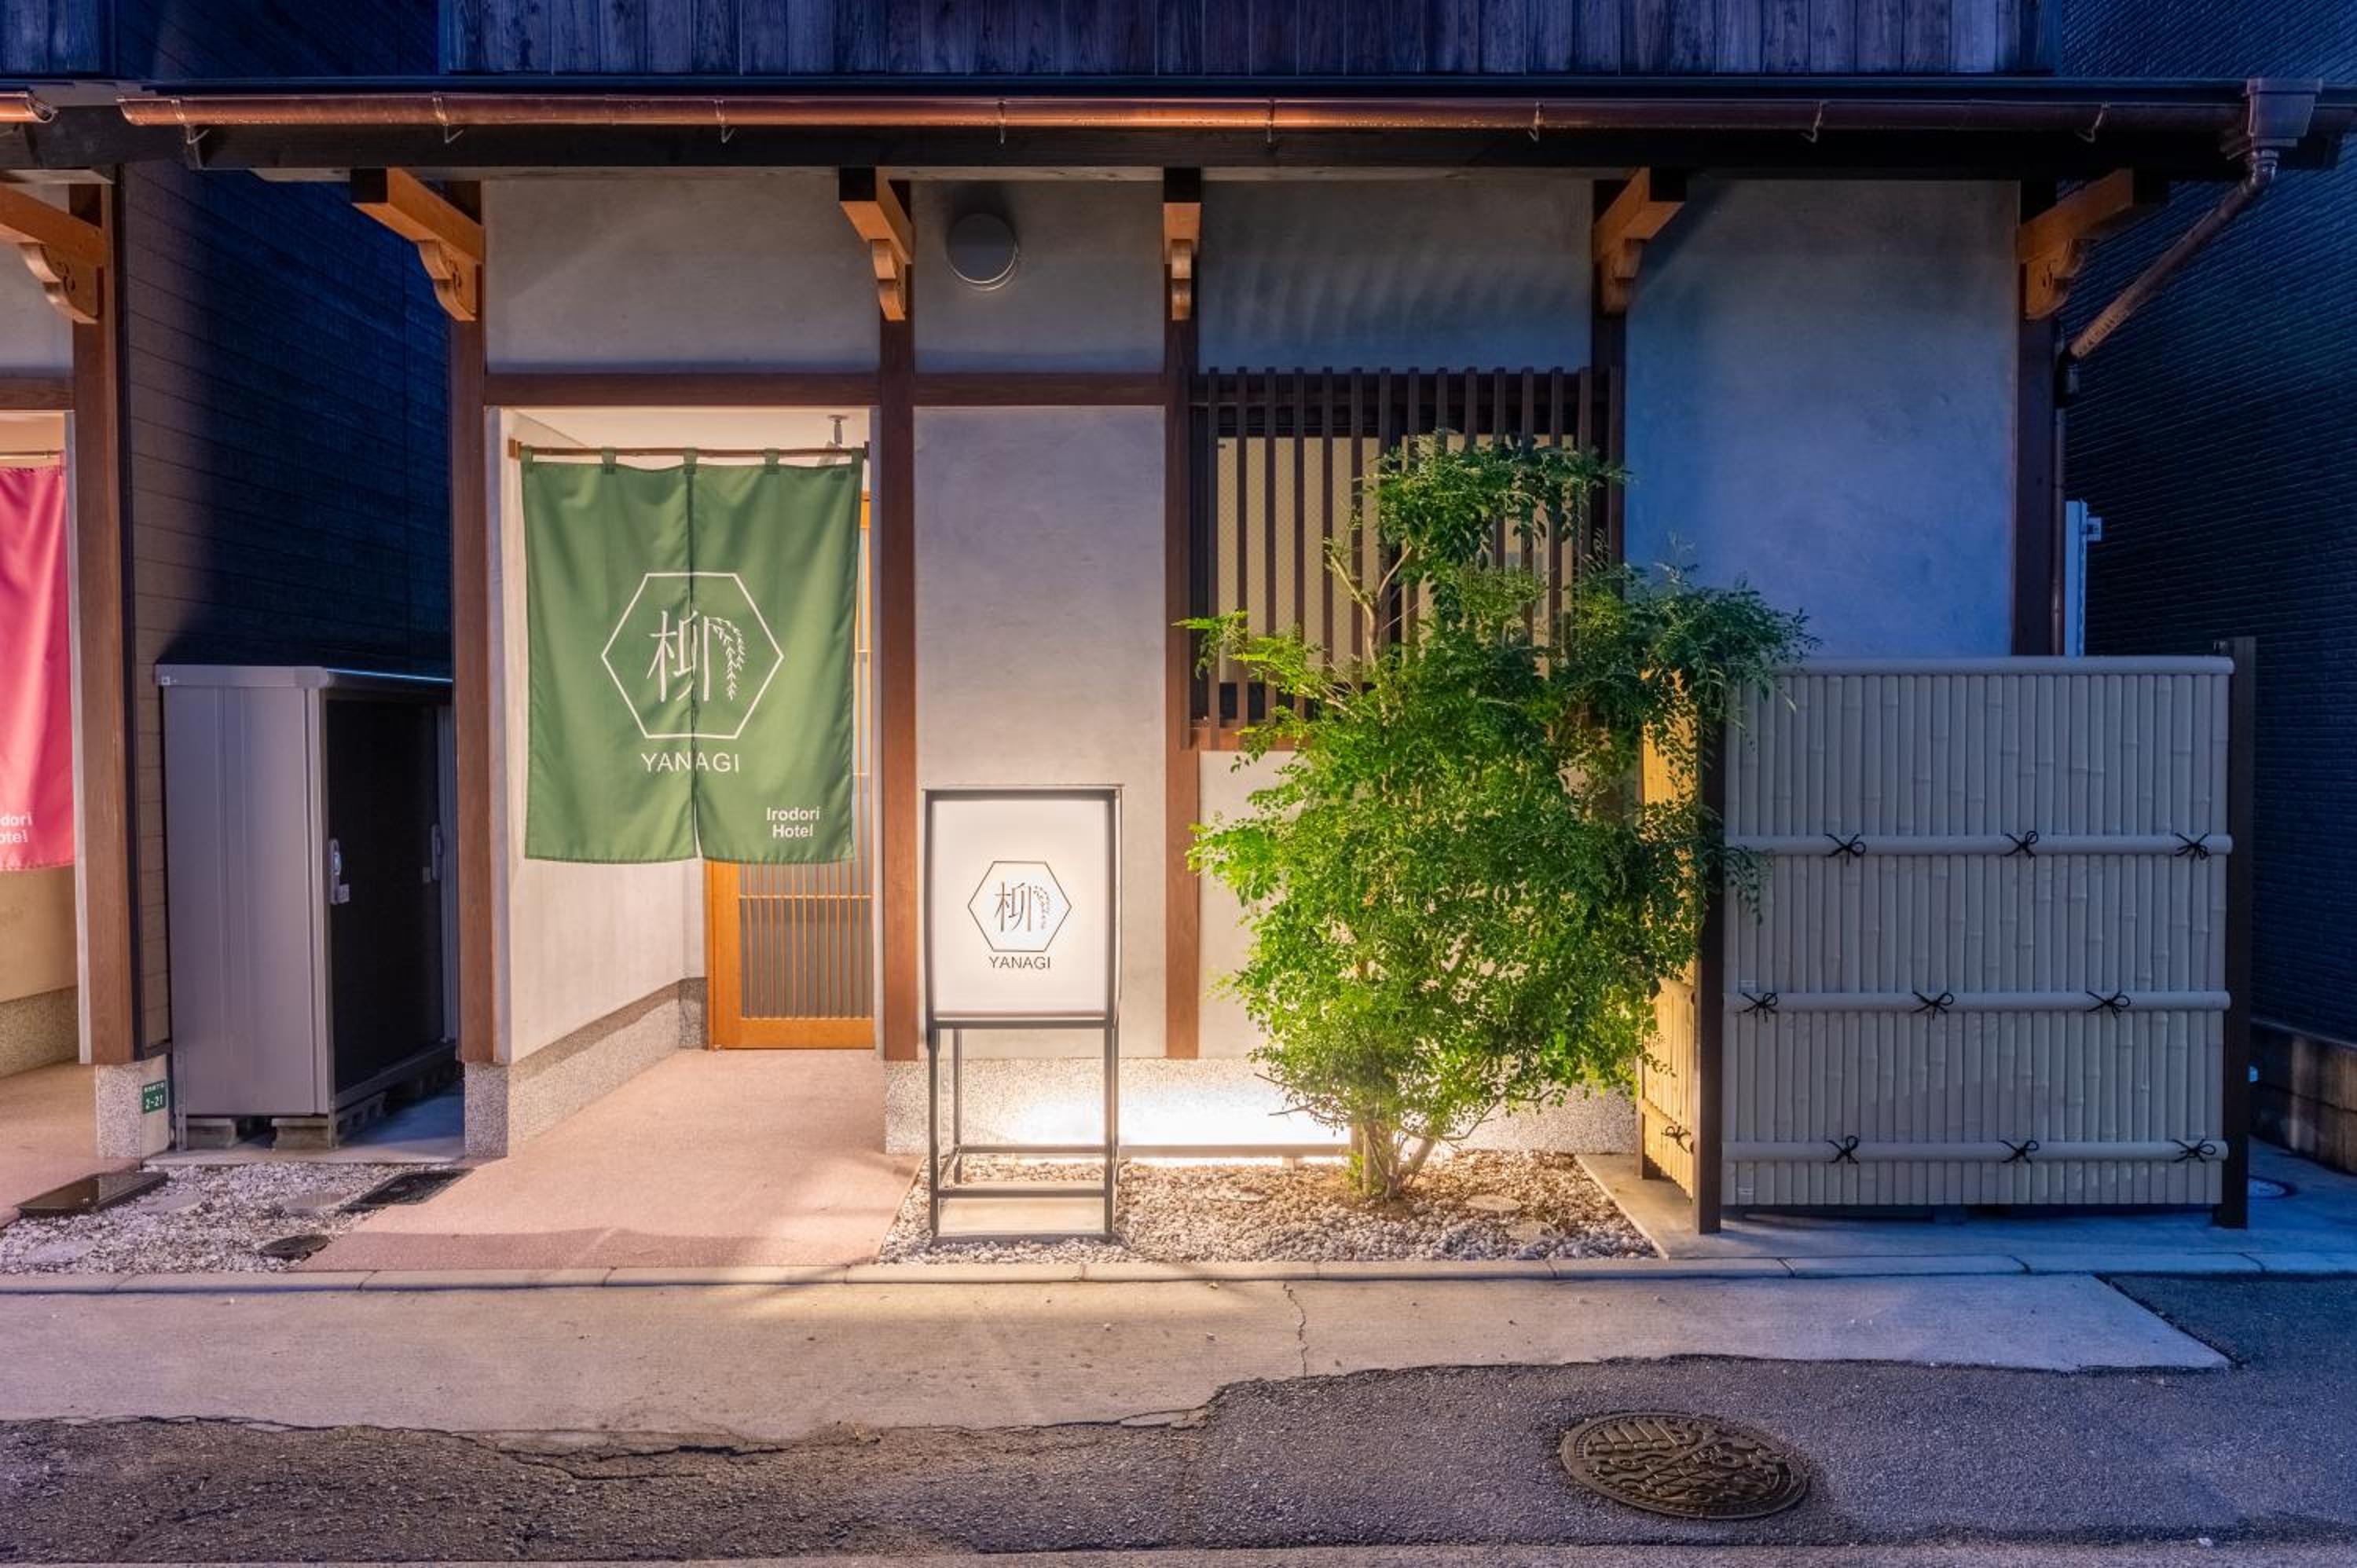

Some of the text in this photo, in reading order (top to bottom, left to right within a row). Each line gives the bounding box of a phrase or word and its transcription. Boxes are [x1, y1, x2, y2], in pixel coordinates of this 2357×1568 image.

[647, 610, 745, 702] 柳
[641, 752, 739, 773] YANAGI
[766, 806, 819, 821] Irodori
[772, 823, 813, 839] Hotel
[994, 881, 1050, 932] 柳
[988, 955, 1050, 969] YANAGI
